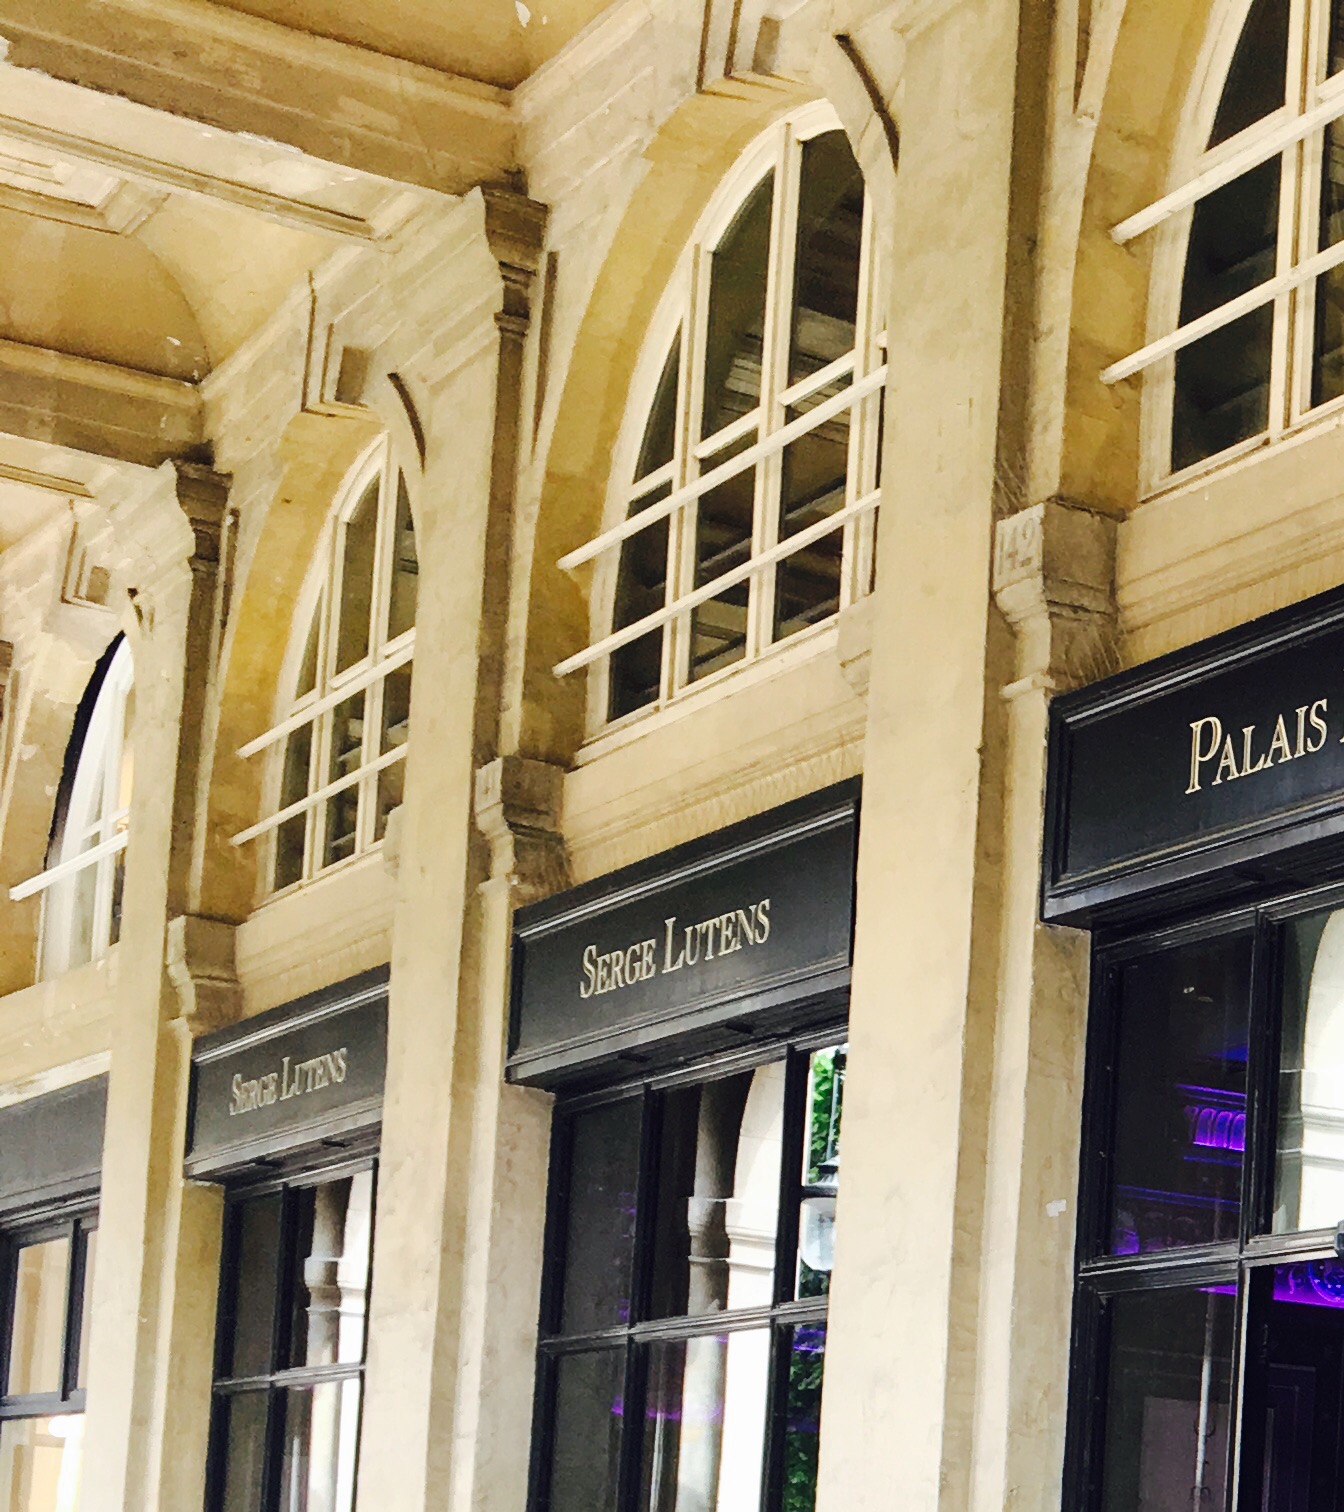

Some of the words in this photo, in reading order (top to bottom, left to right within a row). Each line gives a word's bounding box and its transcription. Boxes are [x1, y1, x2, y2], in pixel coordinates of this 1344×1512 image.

[1184, 698, 1328, 795] PALAIS
[579, 939, 657, 999] SERGE
[661, 898, 770, 974] LUTENS
[280, 1047, 347, 1100] LUTENS
